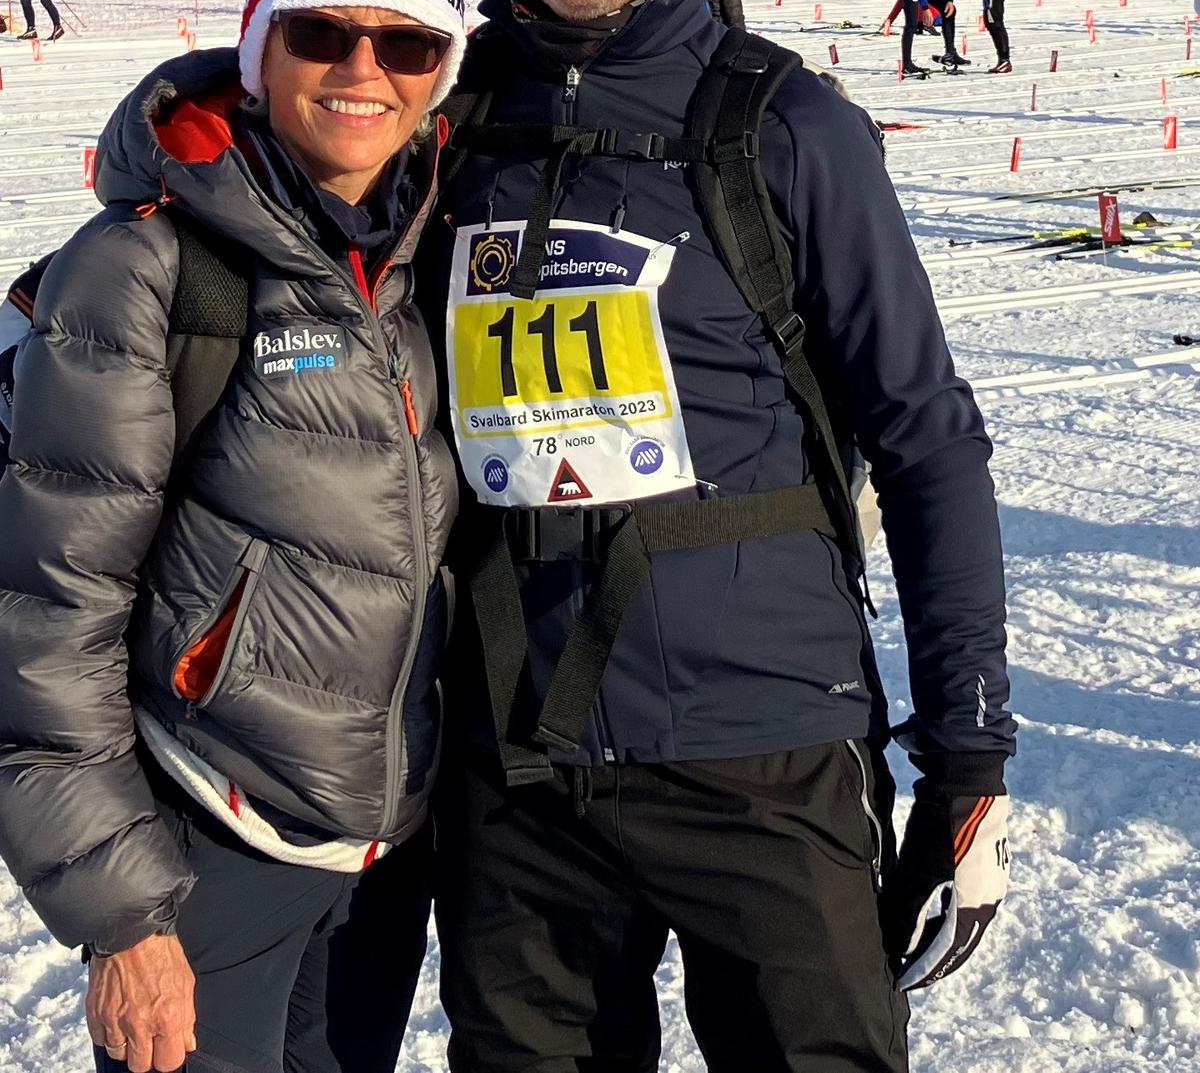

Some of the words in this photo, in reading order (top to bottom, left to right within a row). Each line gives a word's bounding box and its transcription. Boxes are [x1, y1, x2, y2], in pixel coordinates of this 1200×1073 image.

[537, 259, 629, 280] pitsbergen
[487, 300, 609, 397] 111
[263, 353, 335, 374] maxpulse
[470, 411, 527, 428] Svalbard
[532, 403, 616, 423] Skimaraton
[619, 399, 657, 416] 2023
[565, 435, 596, 448] NORD
